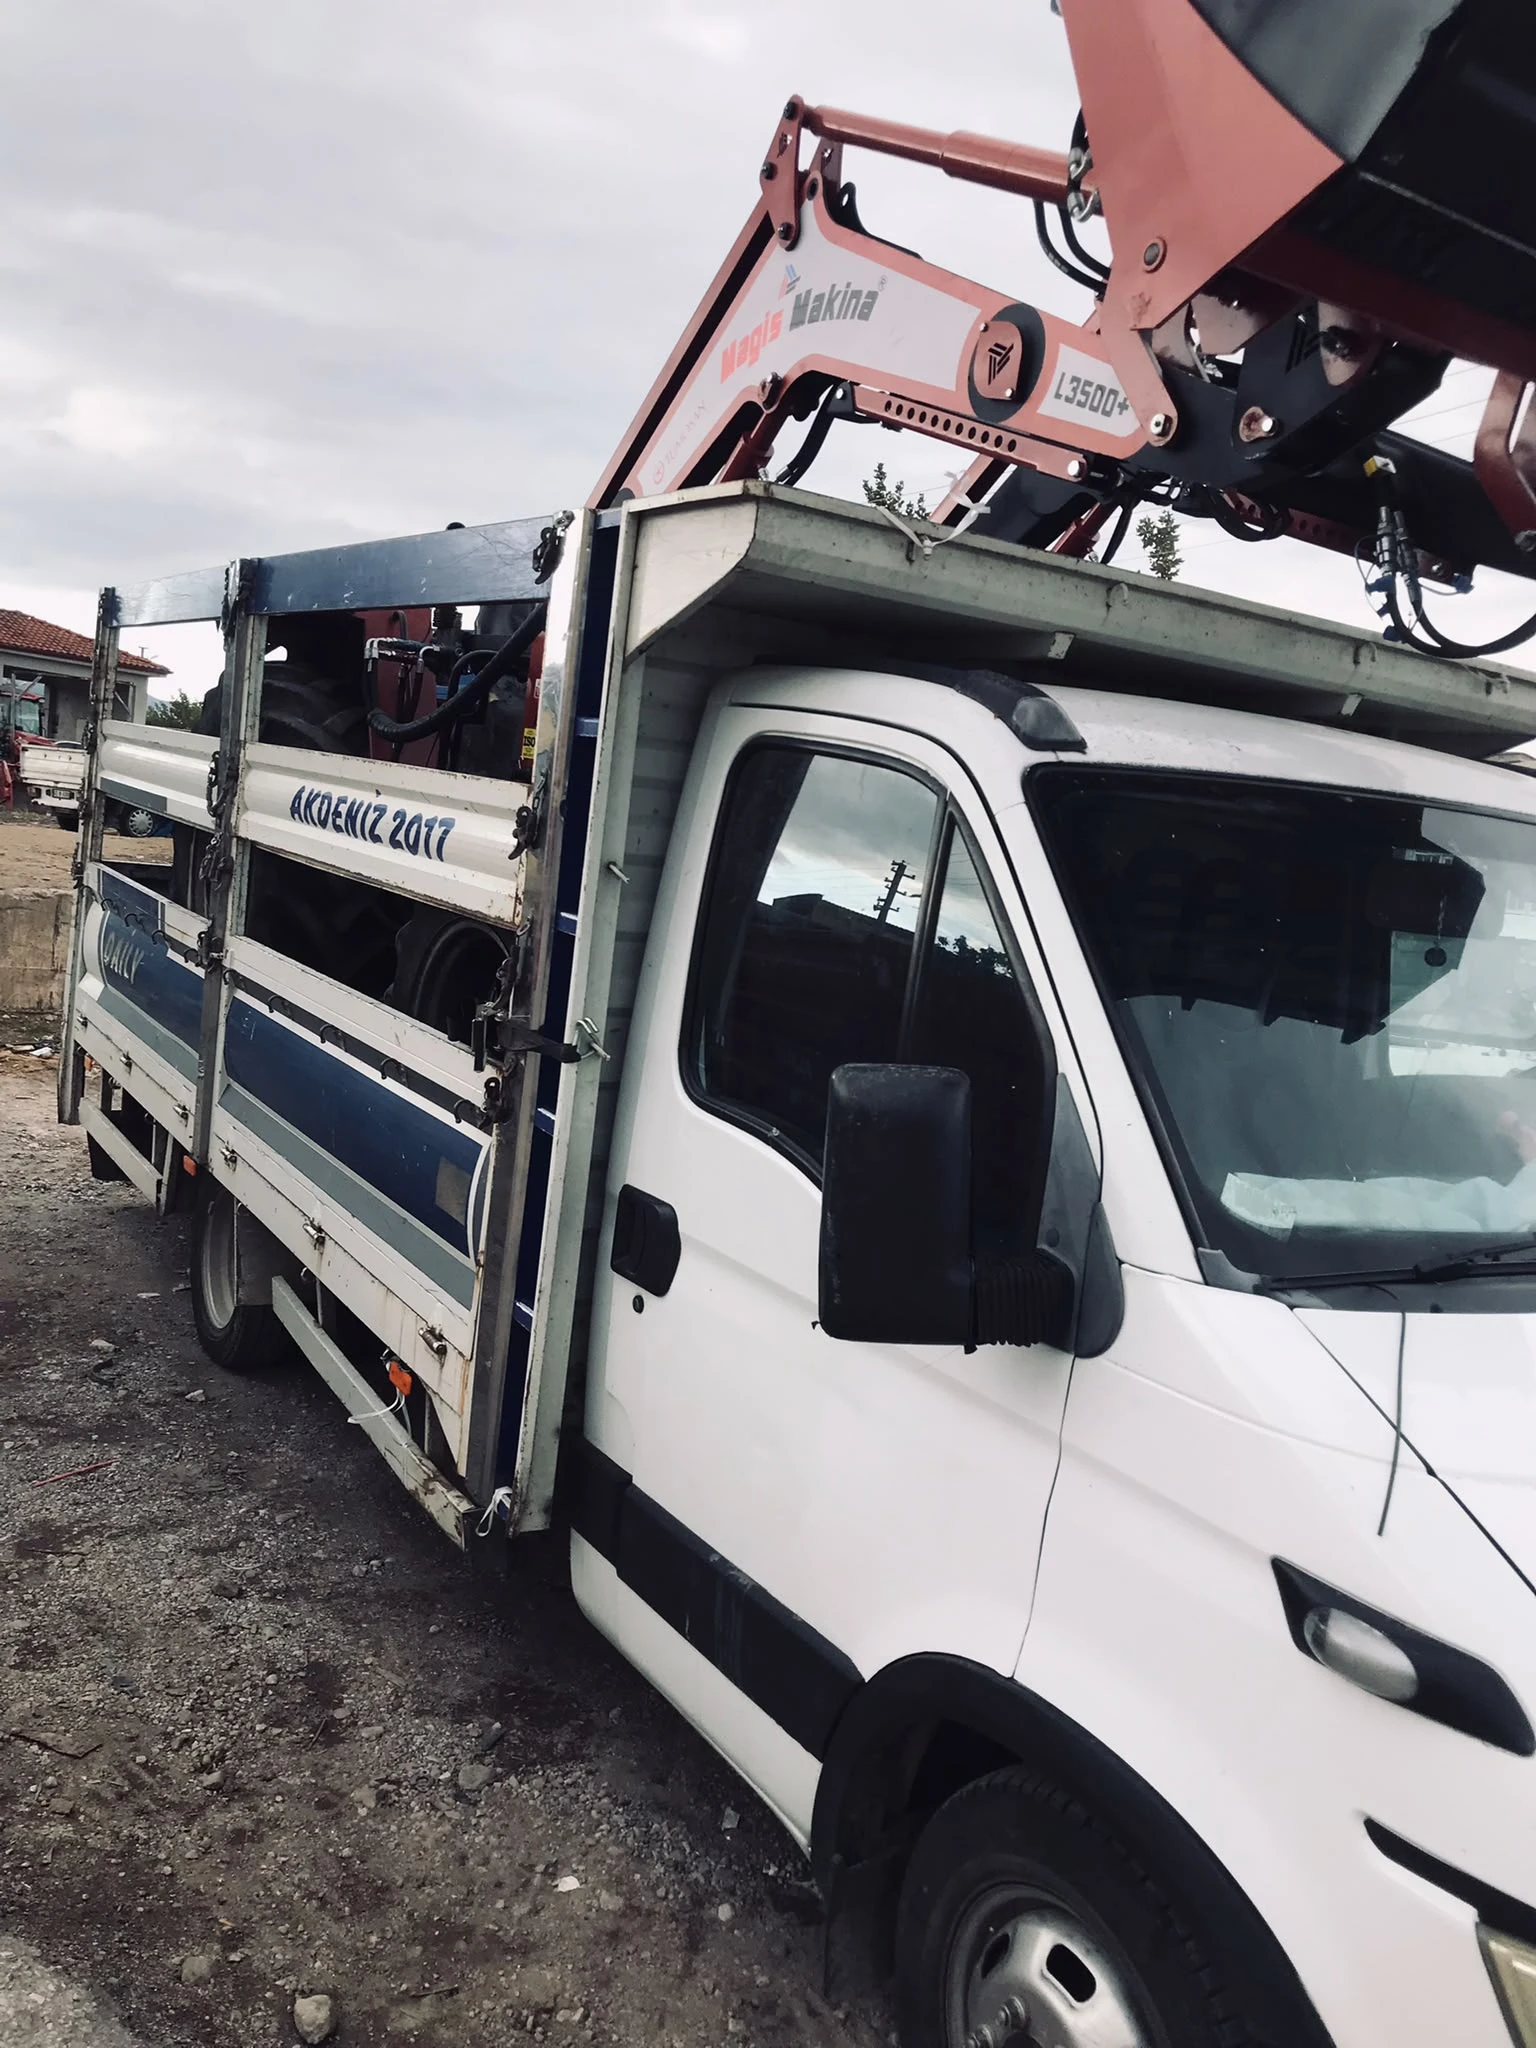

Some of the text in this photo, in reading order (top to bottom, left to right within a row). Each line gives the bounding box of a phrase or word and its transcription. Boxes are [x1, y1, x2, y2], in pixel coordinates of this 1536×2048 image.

[789, 281, 880, 332] Makina
[1053, 371, 1130, 418] L3500+
[389, 808, 456, 863] 2017
